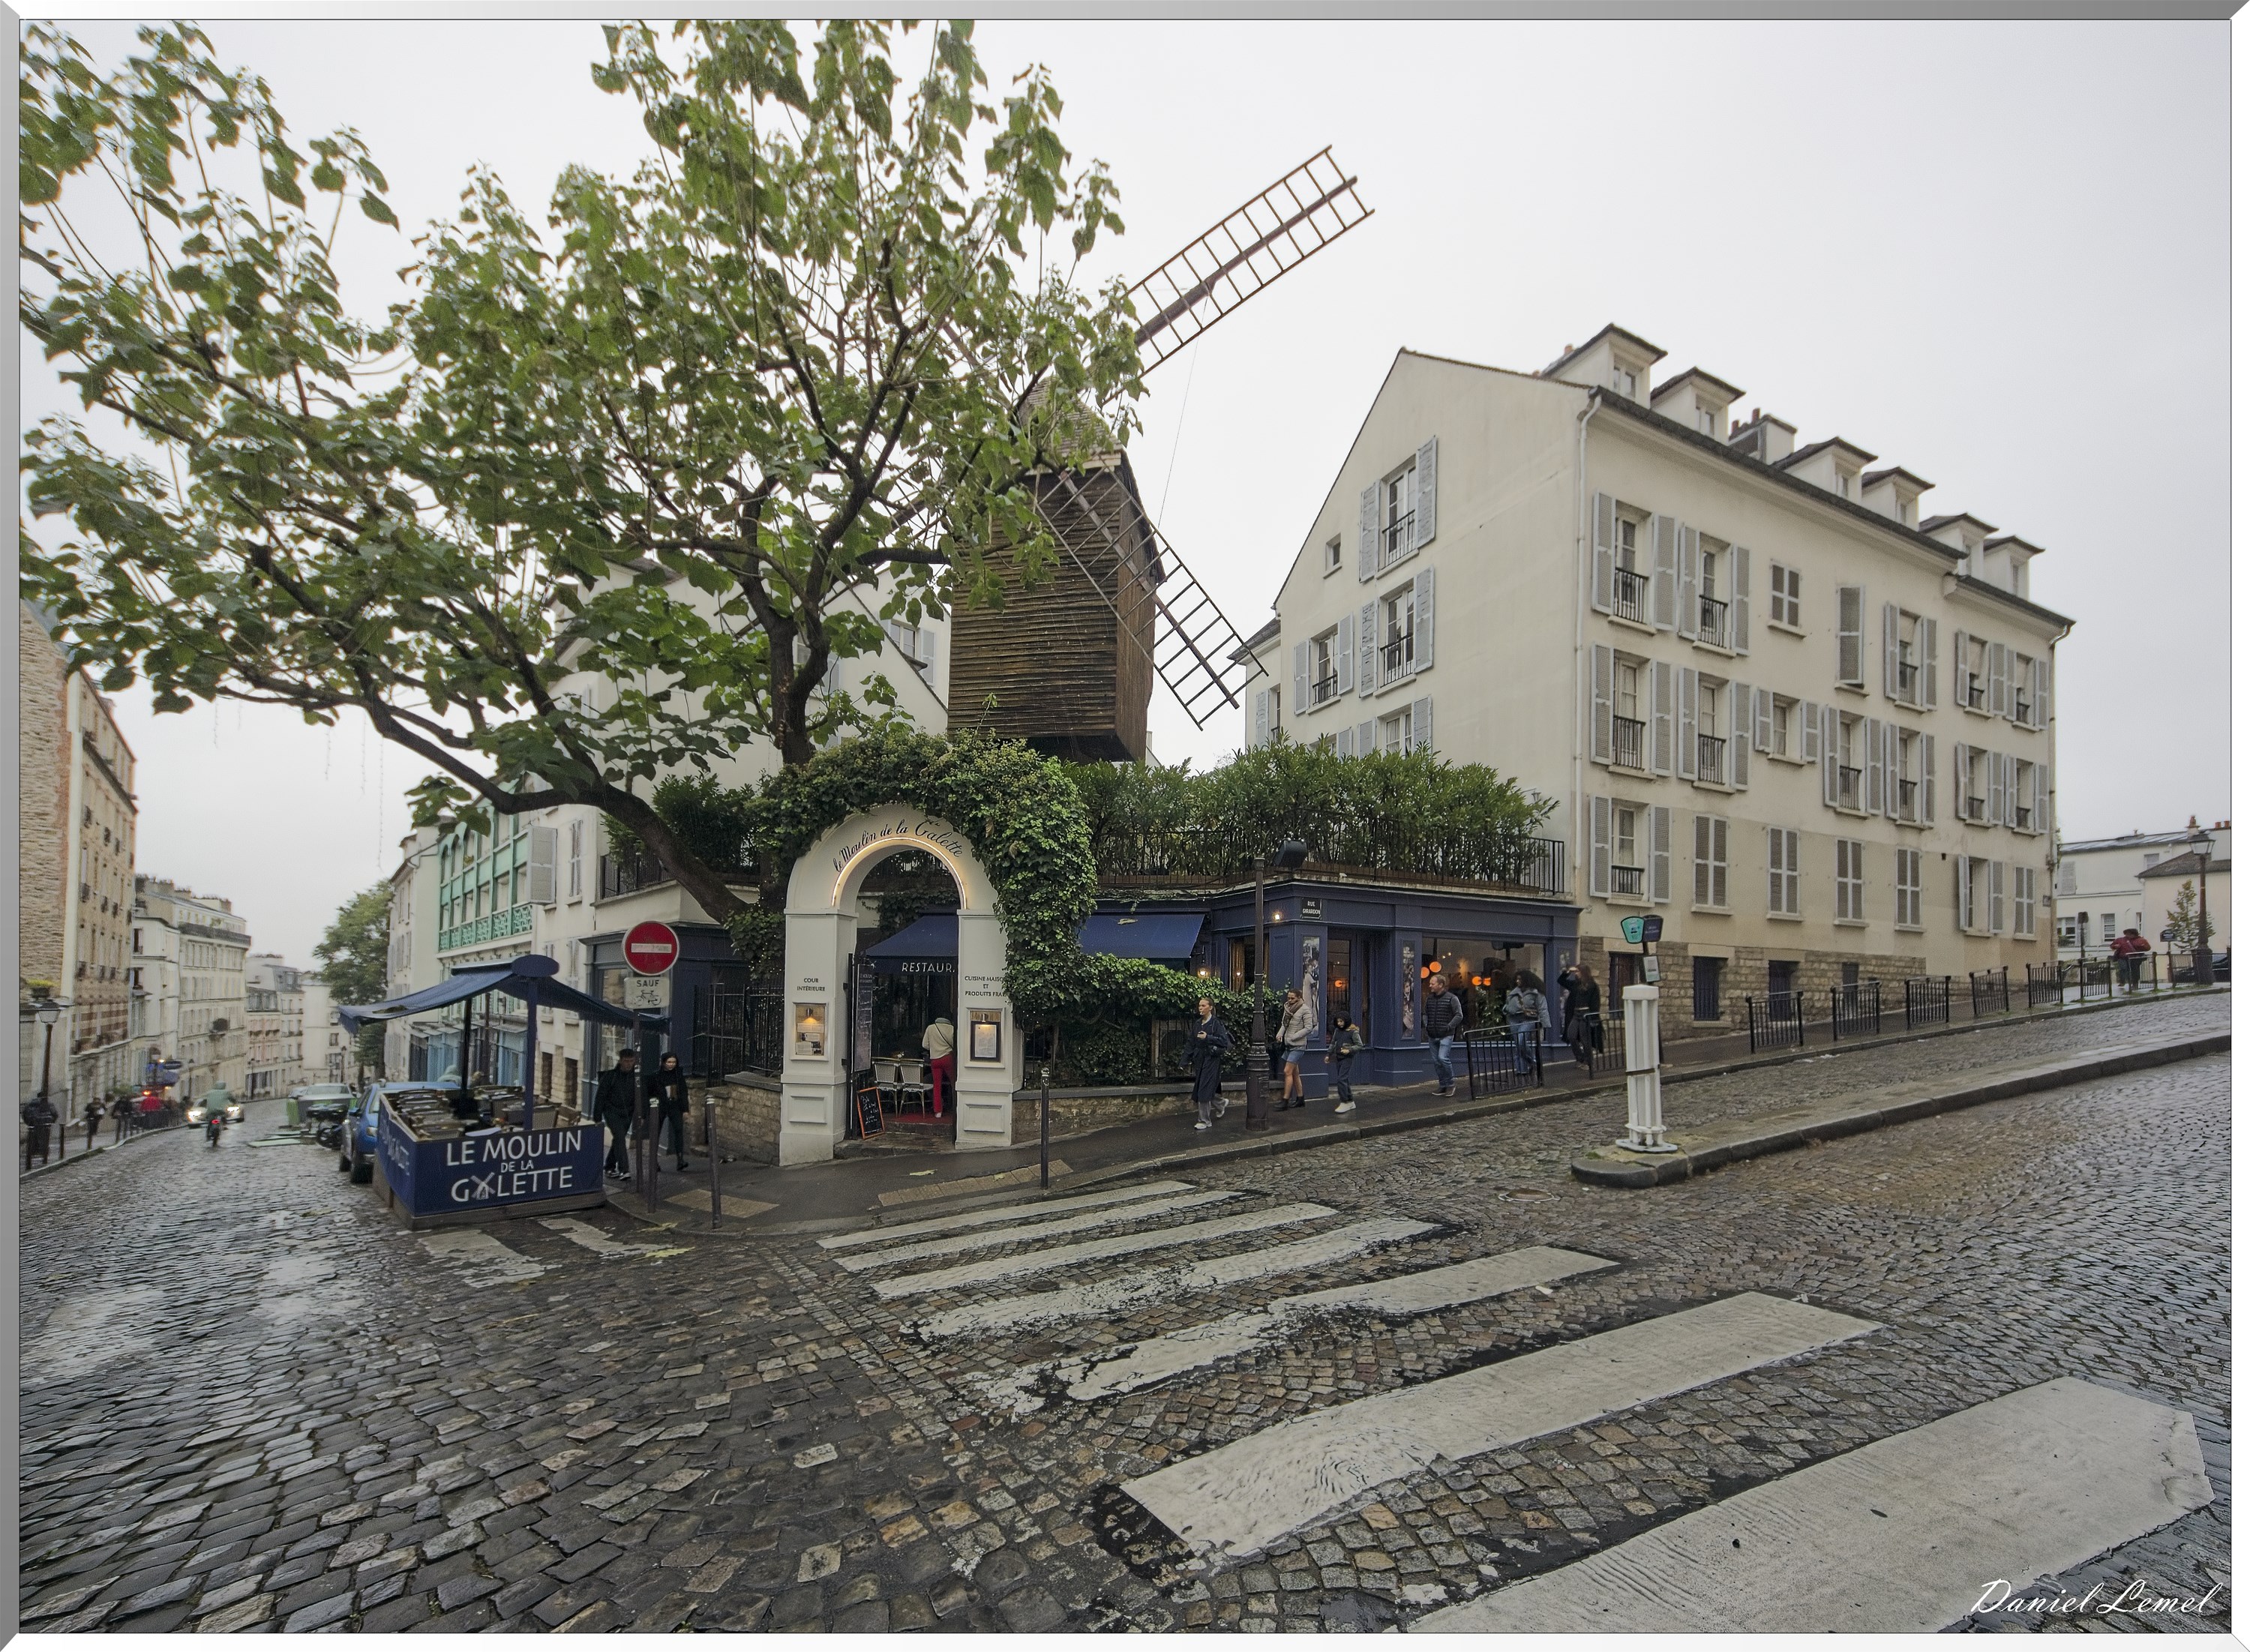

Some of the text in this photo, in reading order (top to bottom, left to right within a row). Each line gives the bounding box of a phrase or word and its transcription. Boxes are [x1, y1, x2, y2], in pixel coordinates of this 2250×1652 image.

[880, 823, 892, 838] de
[896, 818, 908, 835] la
[902, 962, 956, 973] RESTAUR
[636, 979, 660, 988] SAUF
[447, 1130, 581, 1166] LE MOULIN
[501, 1159, 534, 1173] DE LA
